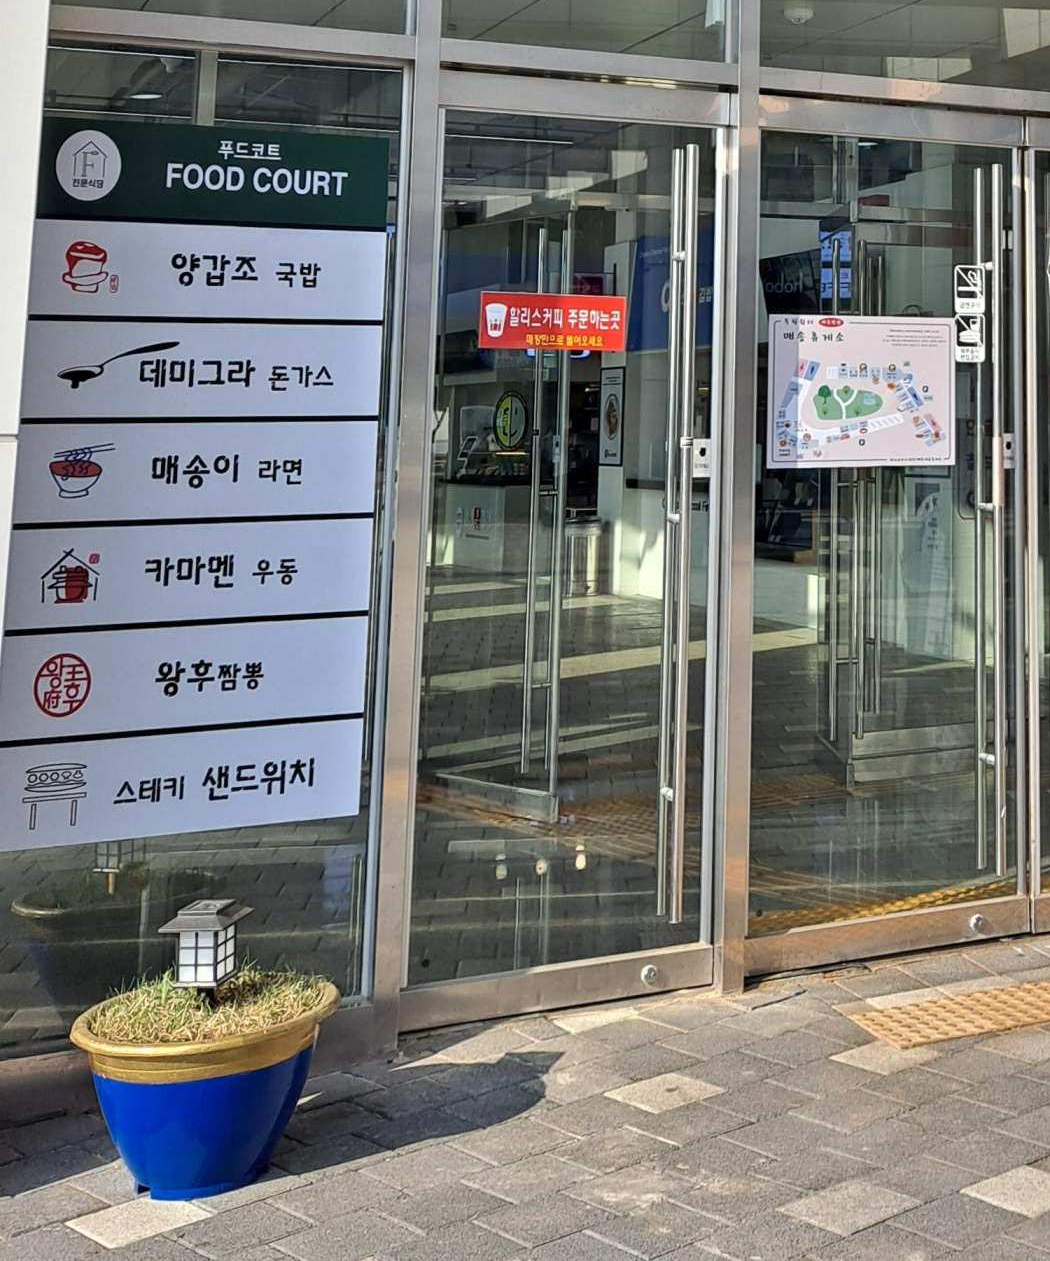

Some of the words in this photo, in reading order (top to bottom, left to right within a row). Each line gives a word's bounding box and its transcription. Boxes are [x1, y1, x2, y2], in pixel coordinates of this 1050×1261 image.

[217, 140, 282, 161] 푸드코트
[165, 163, 245, 191] FOOD
[252, 166, 349, 196] COURT
[275, 262, 322, 289] 국밥
[509, 307, 563, 328] 할리스커피
[138, 360, 256, 388] 데미그라
[268, 365, 335, 391] 돈가스
[151, 454, 240, 488] 매송이
[258, 458, 303, 485] 라면
[144, 554, 235, 589] 카마멘
[252, 558, 299, 585] 우동
[113, 775, 186, 805] 스테키
[201, 757, 316, 801] 샌드위치
